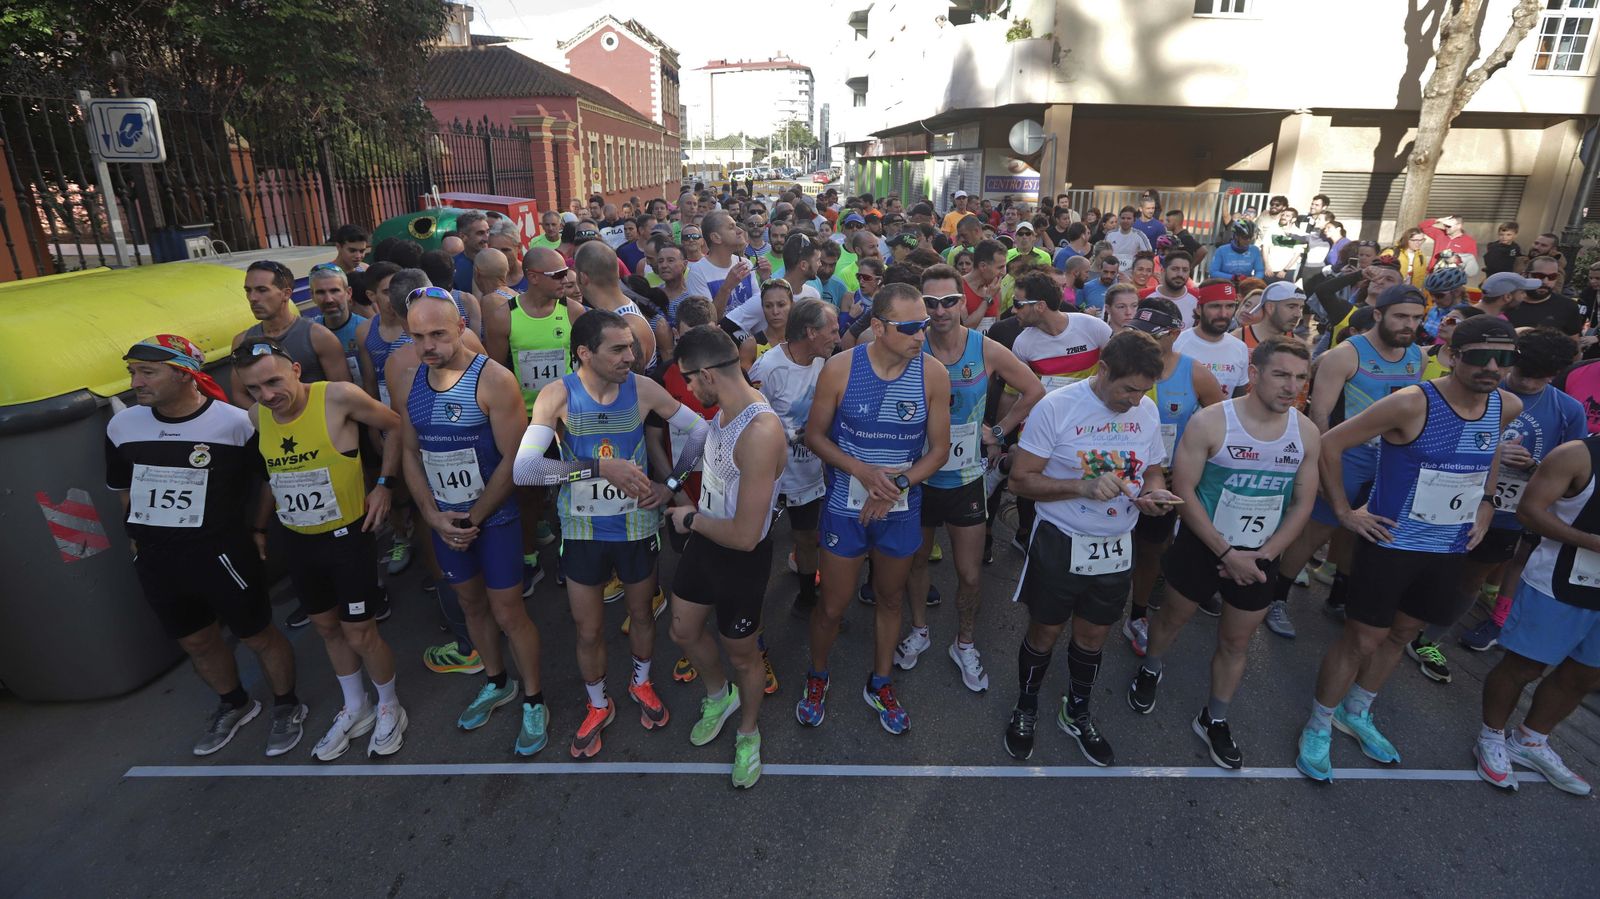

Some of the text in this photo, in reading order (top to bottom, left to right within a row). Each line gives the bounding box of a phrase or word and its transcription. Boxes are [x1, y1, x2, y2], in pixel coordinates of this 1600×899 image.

[987, 179, 1021, 190] CENTRO
[532, 364, 559, 379] 141
[453, 434, 480, 442] Linense
[856, 430, 897, 440] Atletismo
[267, 450, 319, 467] SAYSKY
[1439, 463, 1475, 471] Atletismo
[437, 469, 472, 489] 140
[148, 488, 192, 509] 155
[284, 491, 325, 513] 202
[1449, 492, 1464, 511] 6
[1240, 515, 1266, 533] 75
[1088, 538, 1124, 561] 214
